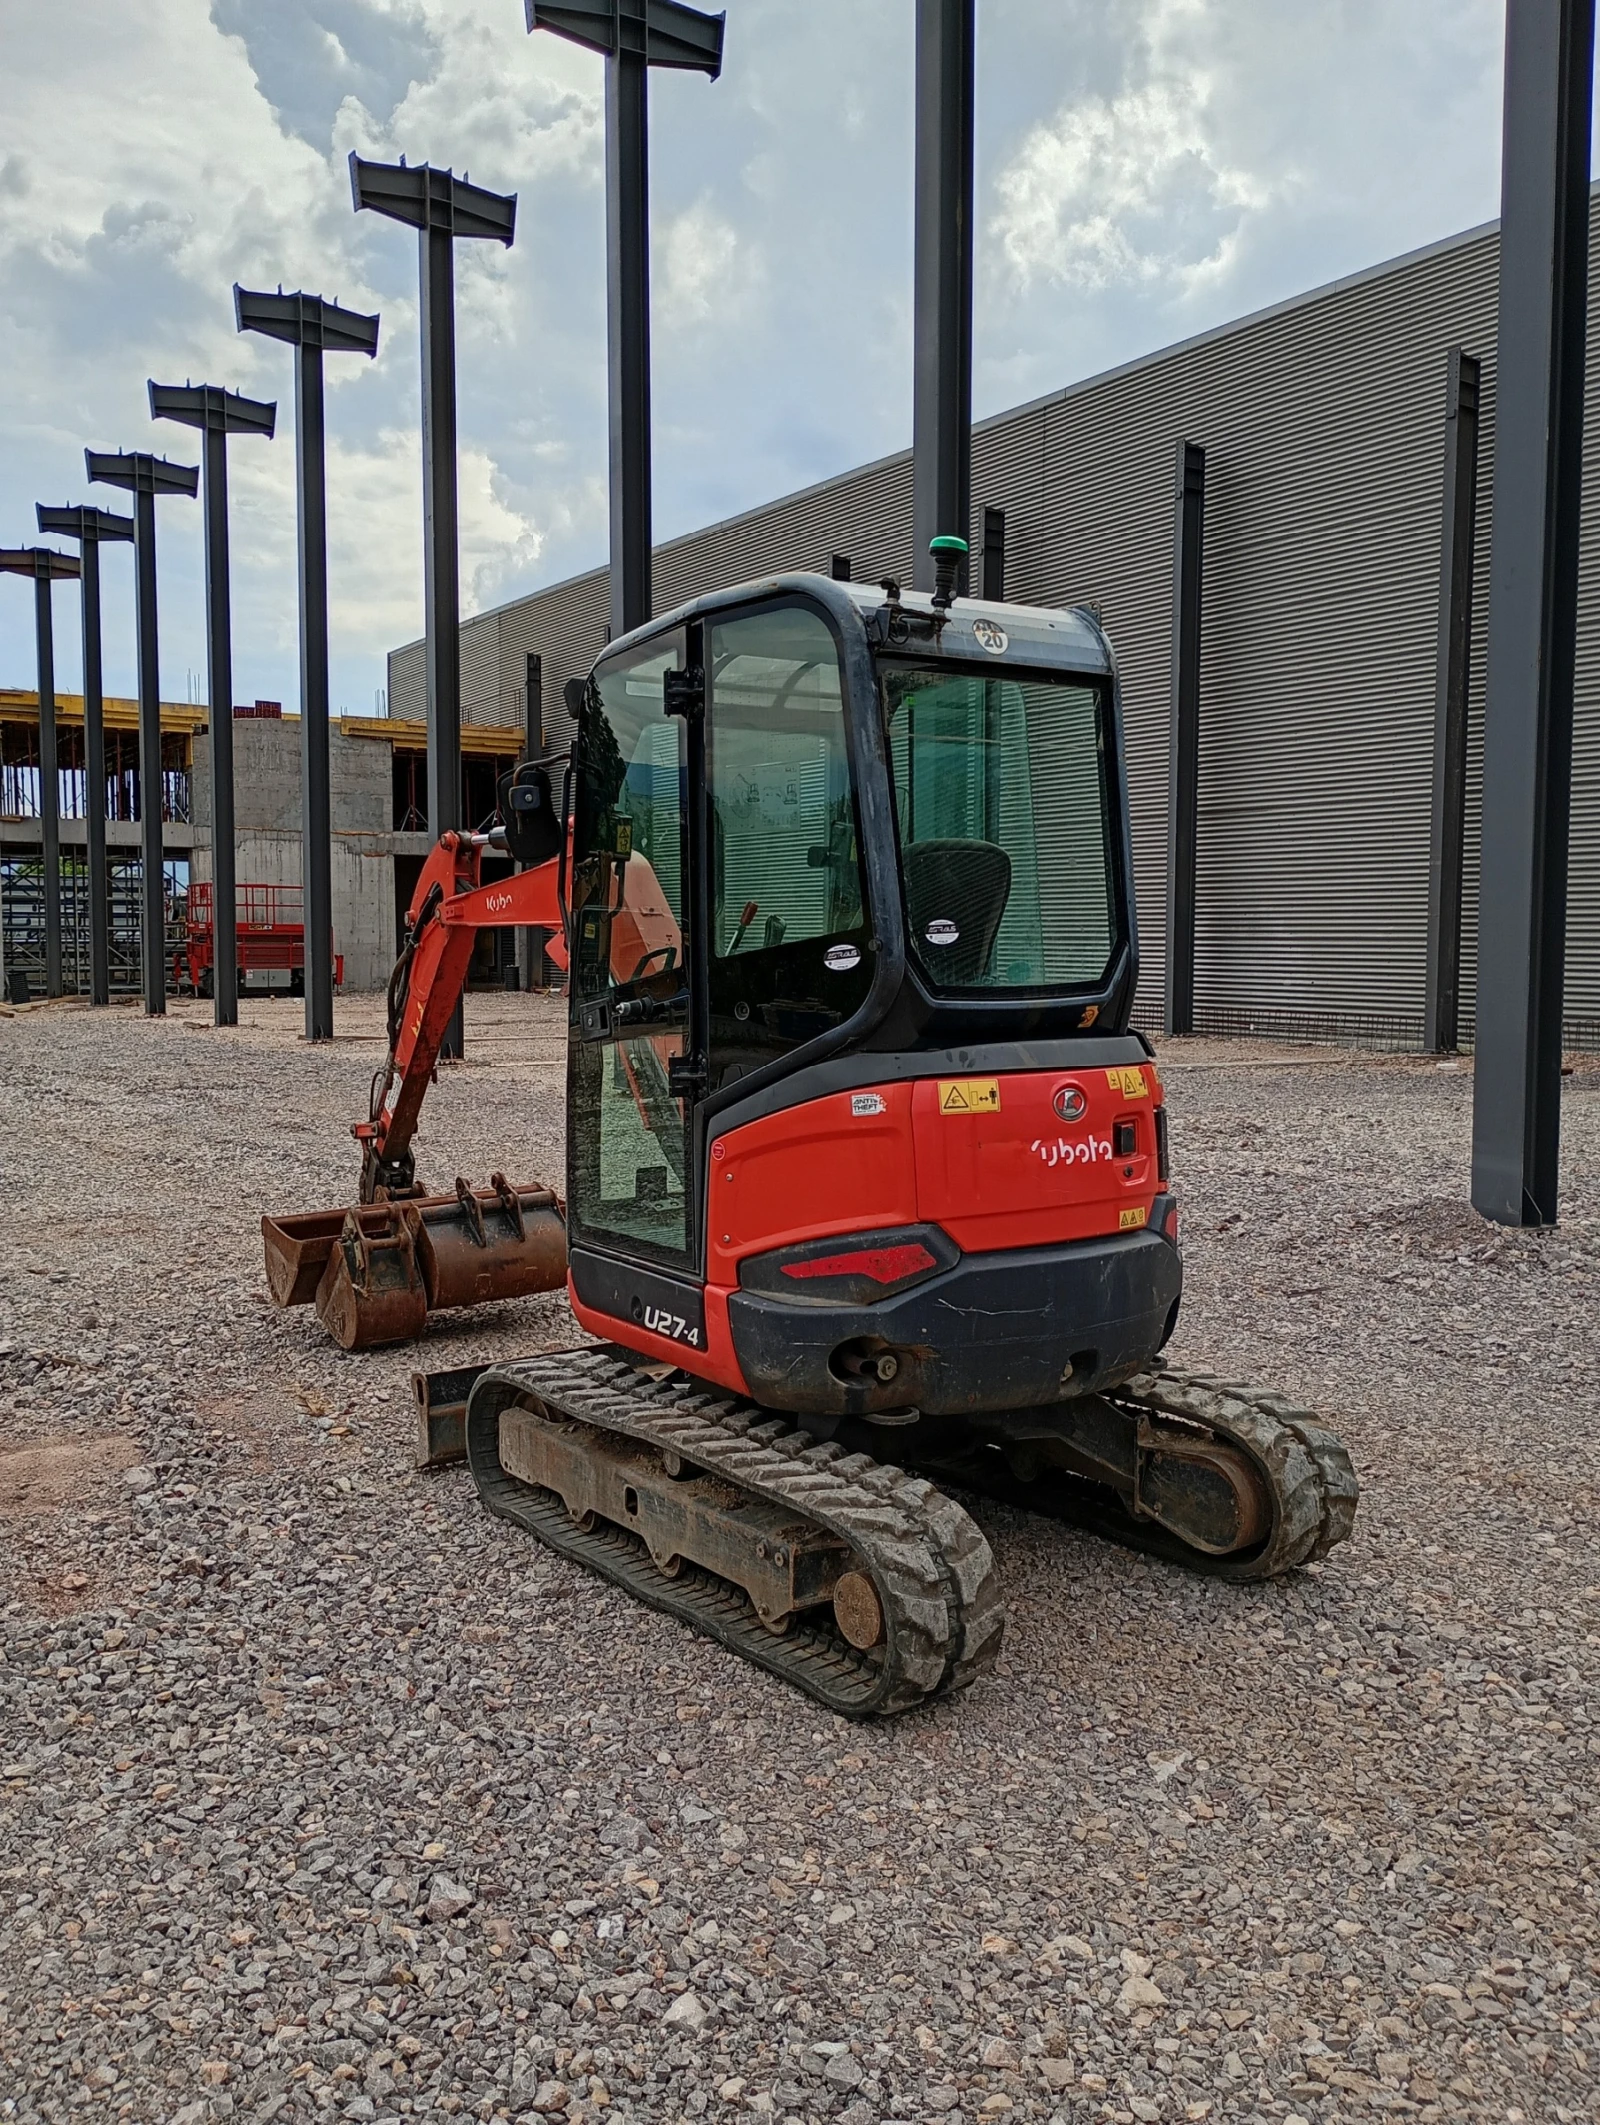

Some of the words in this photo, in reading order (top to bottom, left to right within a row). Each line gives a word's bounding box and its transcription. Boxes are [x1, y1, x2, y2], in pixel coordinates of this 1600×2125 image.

[982, 632, 1003, 649] 20
[853, 1103, 878, 1111] THEFT
[644, 1305, 699, 1346] U27-4
